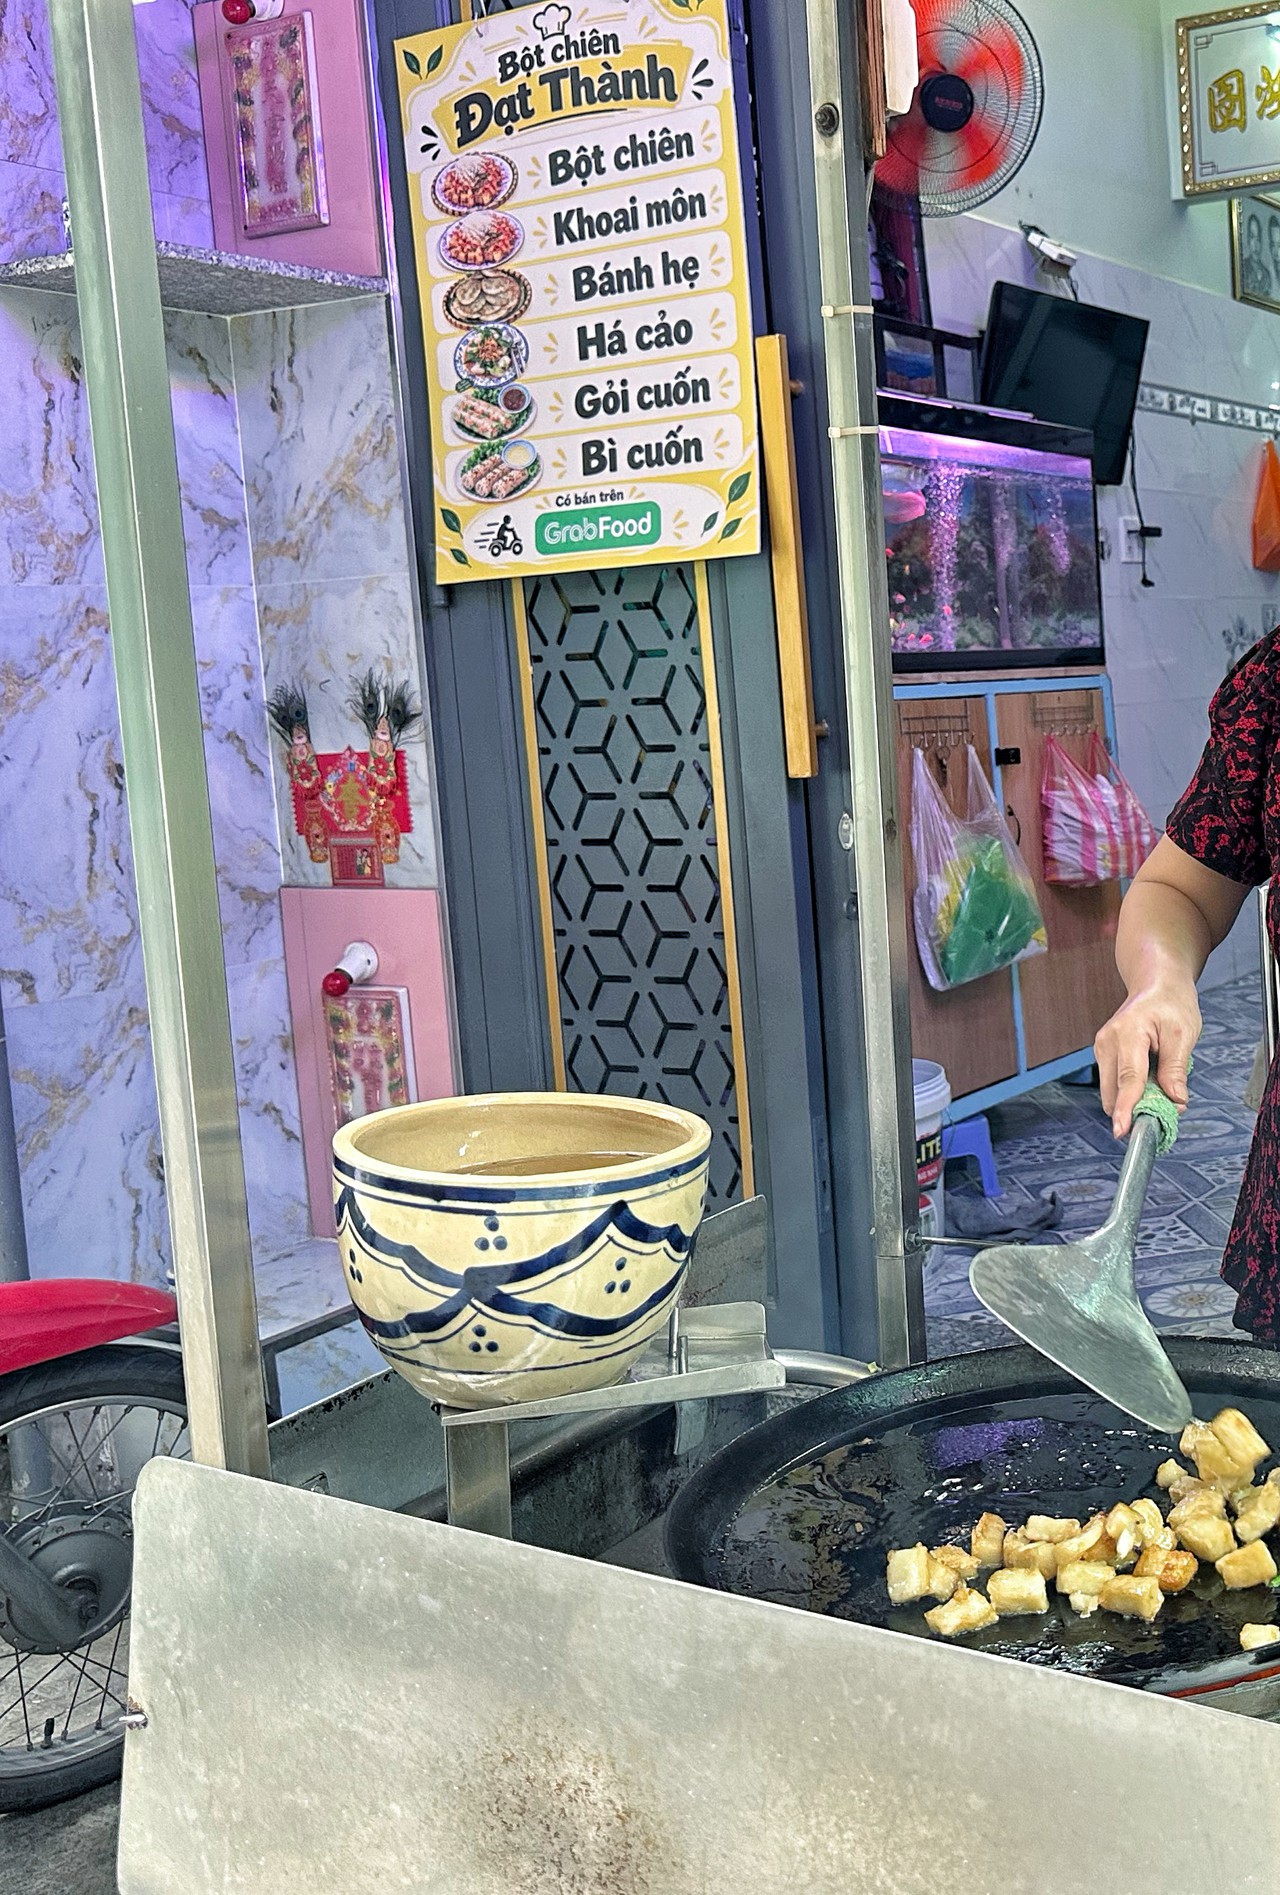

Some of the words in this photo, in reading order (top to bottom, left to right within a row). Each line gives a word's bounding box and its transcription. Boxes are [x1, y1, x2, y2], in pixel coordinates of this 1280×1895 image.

[498, 48, 546, 83] Bột
[551, 28, 621, 62] chiên
[454, 82, 536, 148] Đạt
[538, 54, 678, 113] Thành
[548, 146, 605, 187] Bột
[613, 127, 695, 170] chiên
[553, 196, 639, 246] Khoai
[645, 188, 707, 229] môn
[572, 256, 653, 302] Bánh
[661, 251, 700, 289] hẹ
[576, 320, 628, 361] Há
[635, 309, 694, 356] cảo
[574, 380, 630, 419] Gỏi
[636, 365, 711, 411] cuốn
[581, 438, 618, 476] Bì
[626, 425, 704, 468] cuốn
[555, 494, 572, 508] Có
[574, 491, 598, 505] bán
[599, 488, 625, 503] trên
[543, 511, 653, 545] GrabFood
